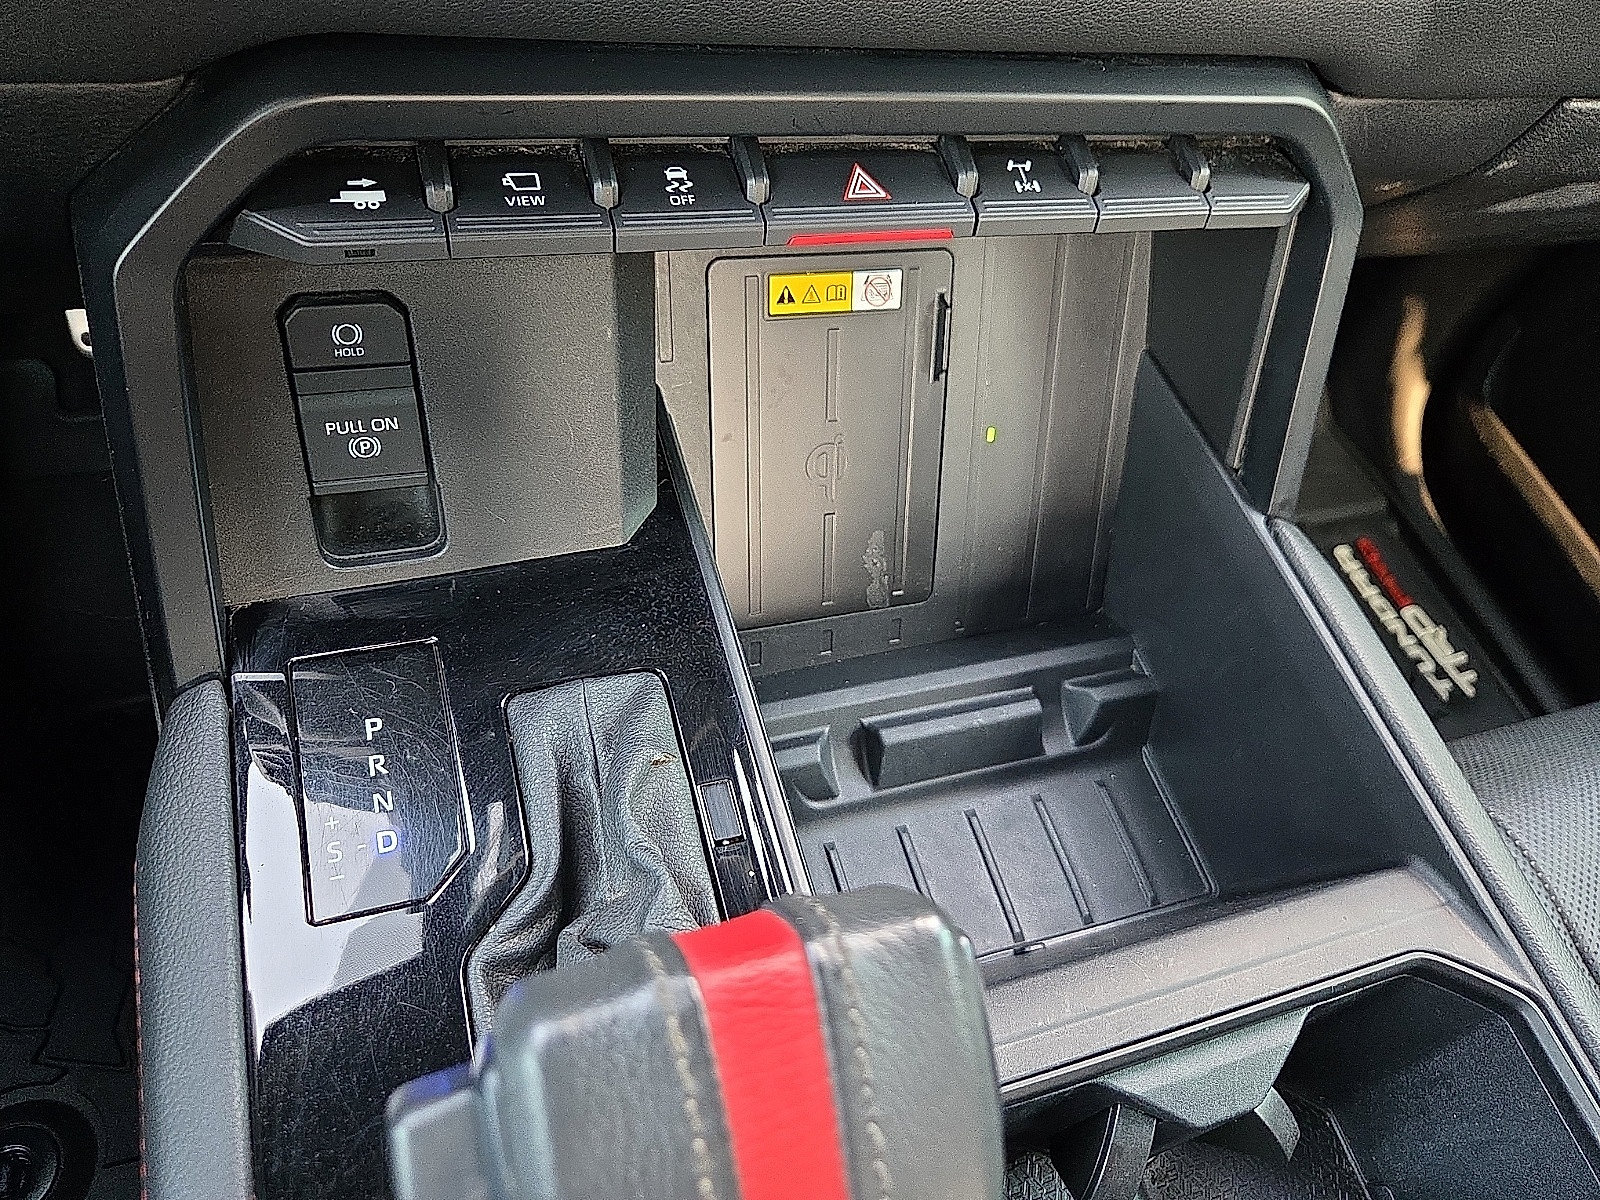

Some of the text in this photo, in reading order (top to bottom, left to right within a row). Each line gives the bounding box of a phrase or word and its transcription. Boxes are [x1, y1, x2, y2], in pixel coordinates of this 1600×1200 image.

[504, 195, 546, 206] VIEW
[669, 195, 696, 206] OFF
[334, 347, 365, 357] HOLD
[325, 416, 399, 436] PULL ON
[364, 717, 383, 741] P
[368, 754, 389, 777] R
[373, 790, 394, 814] N
[326, 840, 343, 864] S
[376, 829, 398, 853] D
